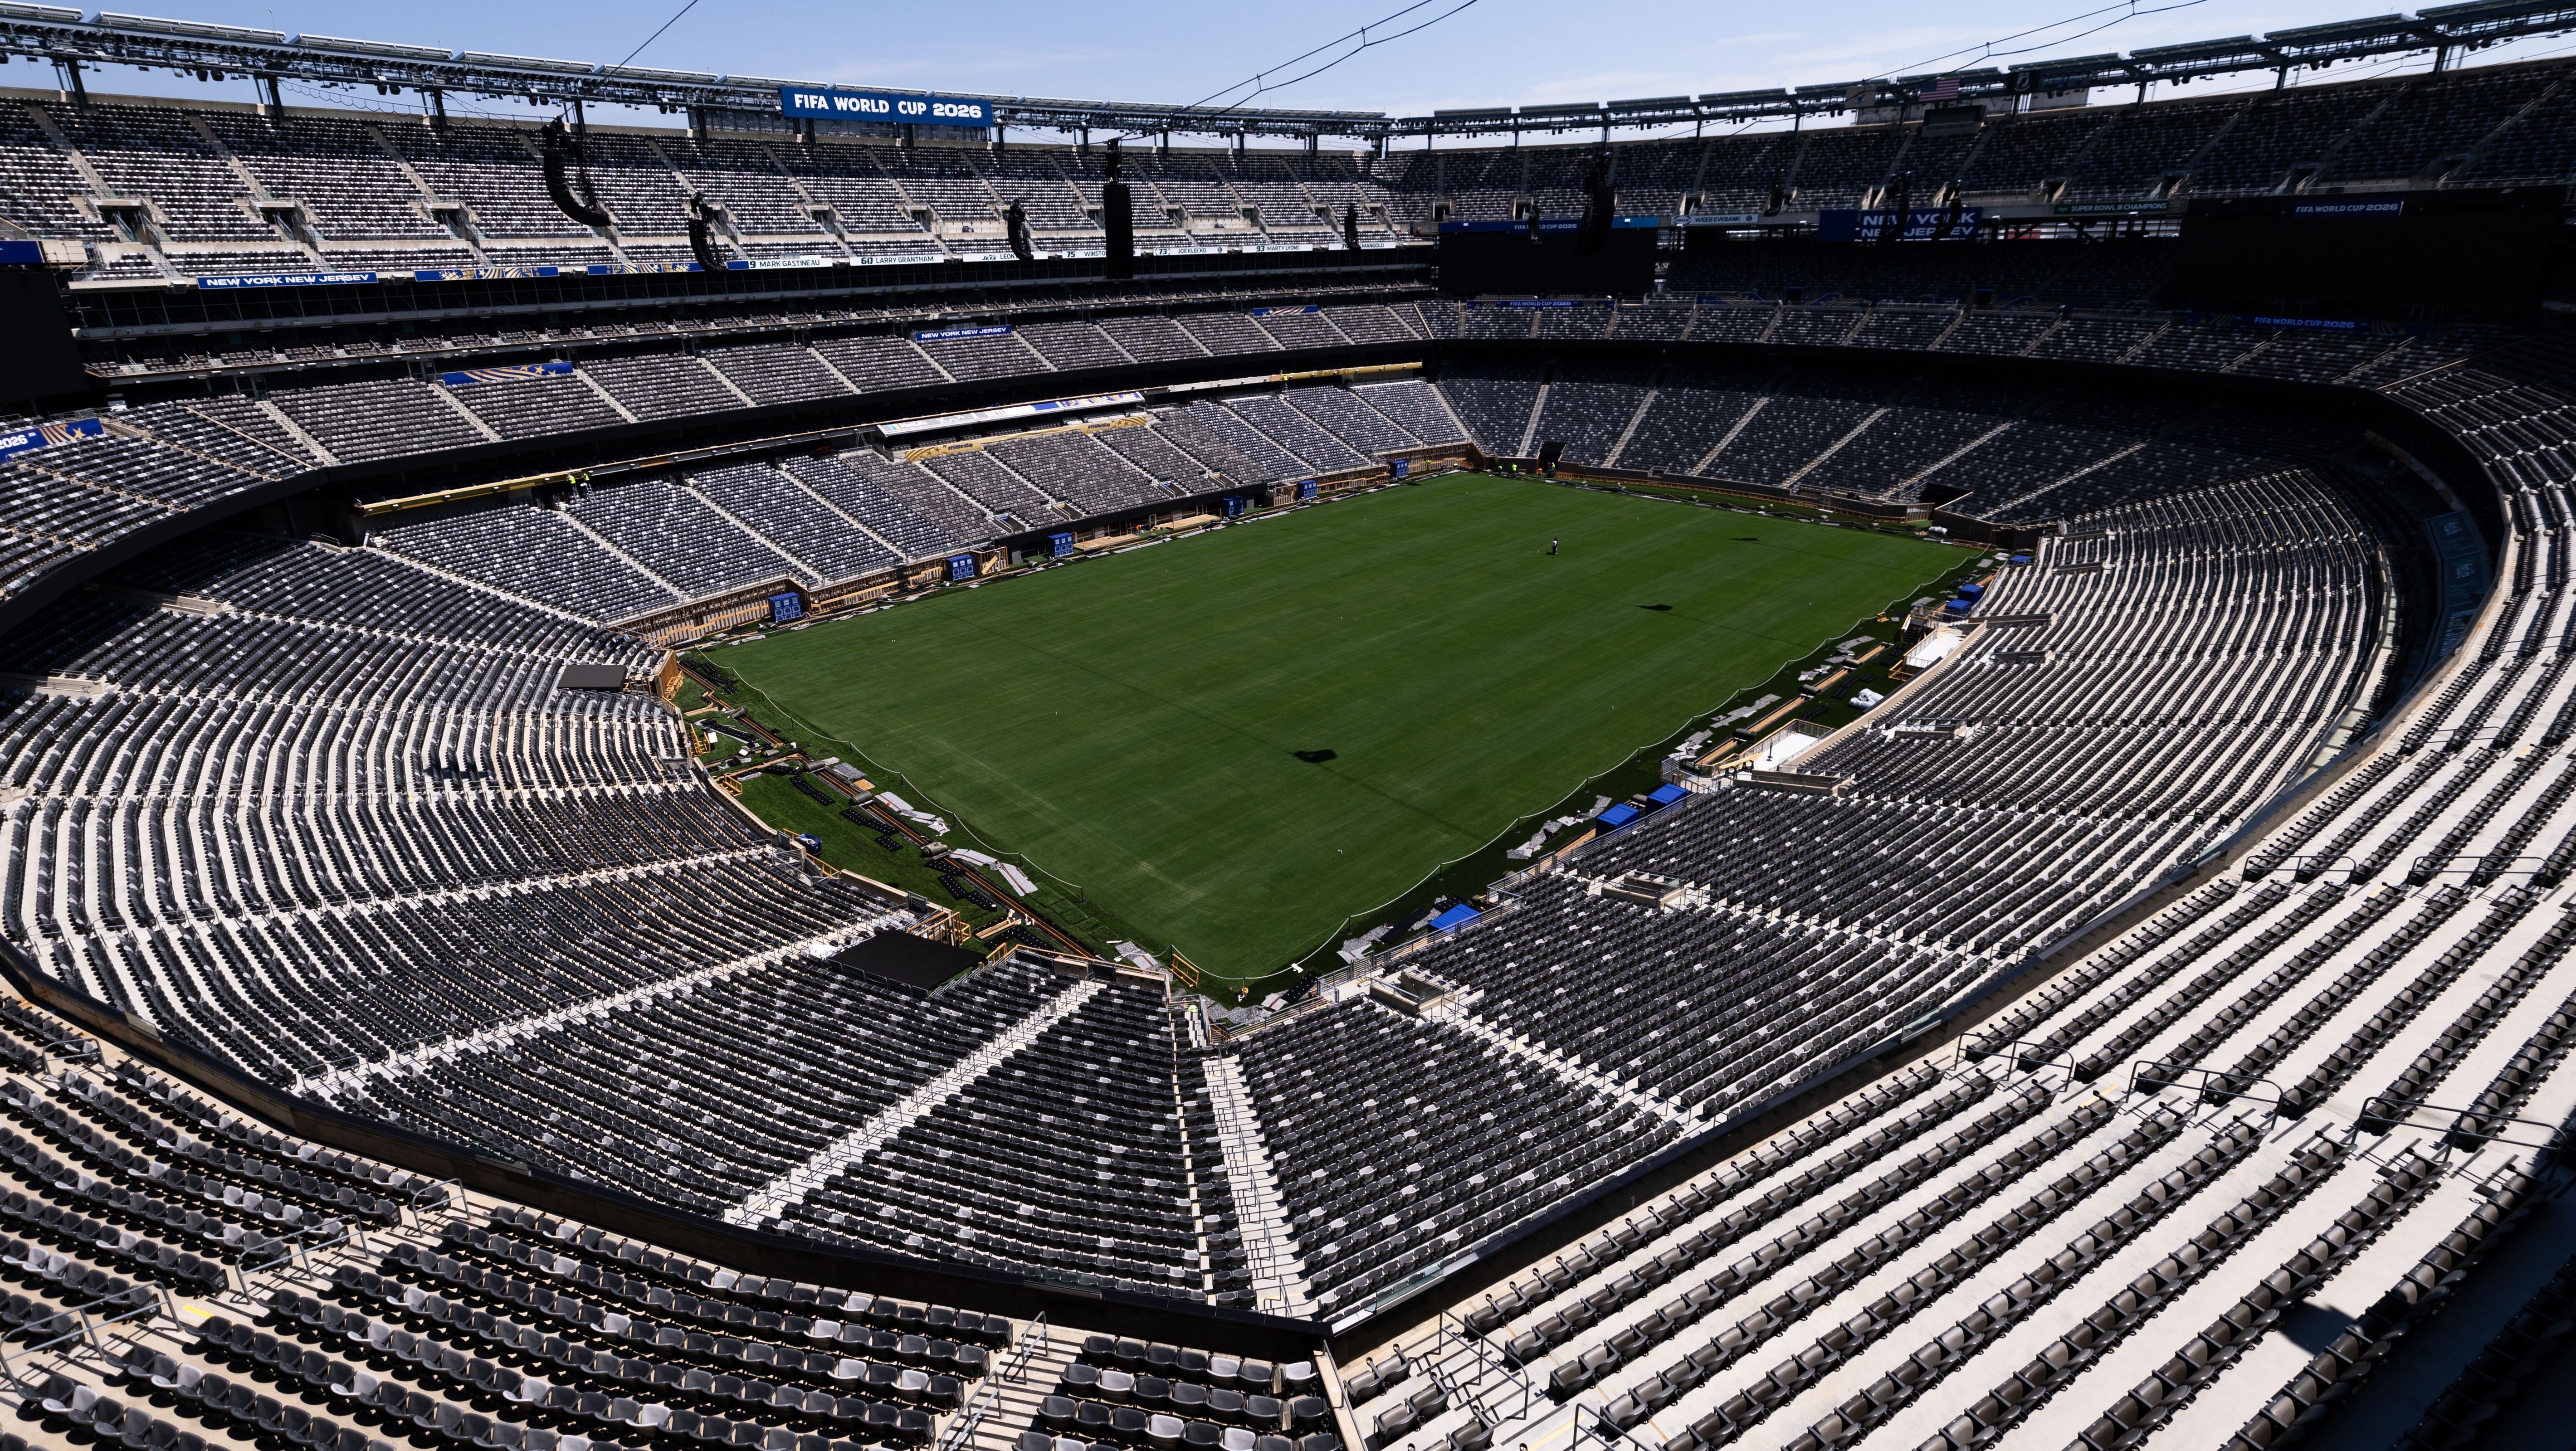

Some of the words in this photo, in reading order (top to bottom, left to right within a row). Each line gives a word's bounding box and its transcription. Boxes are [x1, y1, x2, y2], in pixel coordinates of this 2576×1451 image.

[794, 94, 829, 110] FIFA
[834, 97, 889, 113] WORLD
[898, 101, 927, 115] CUP
[932, 103, 982, 118] 2026
[1903, 226, 1974, 236] JEREY
[2273, 318, 2303, 326] WORLD
